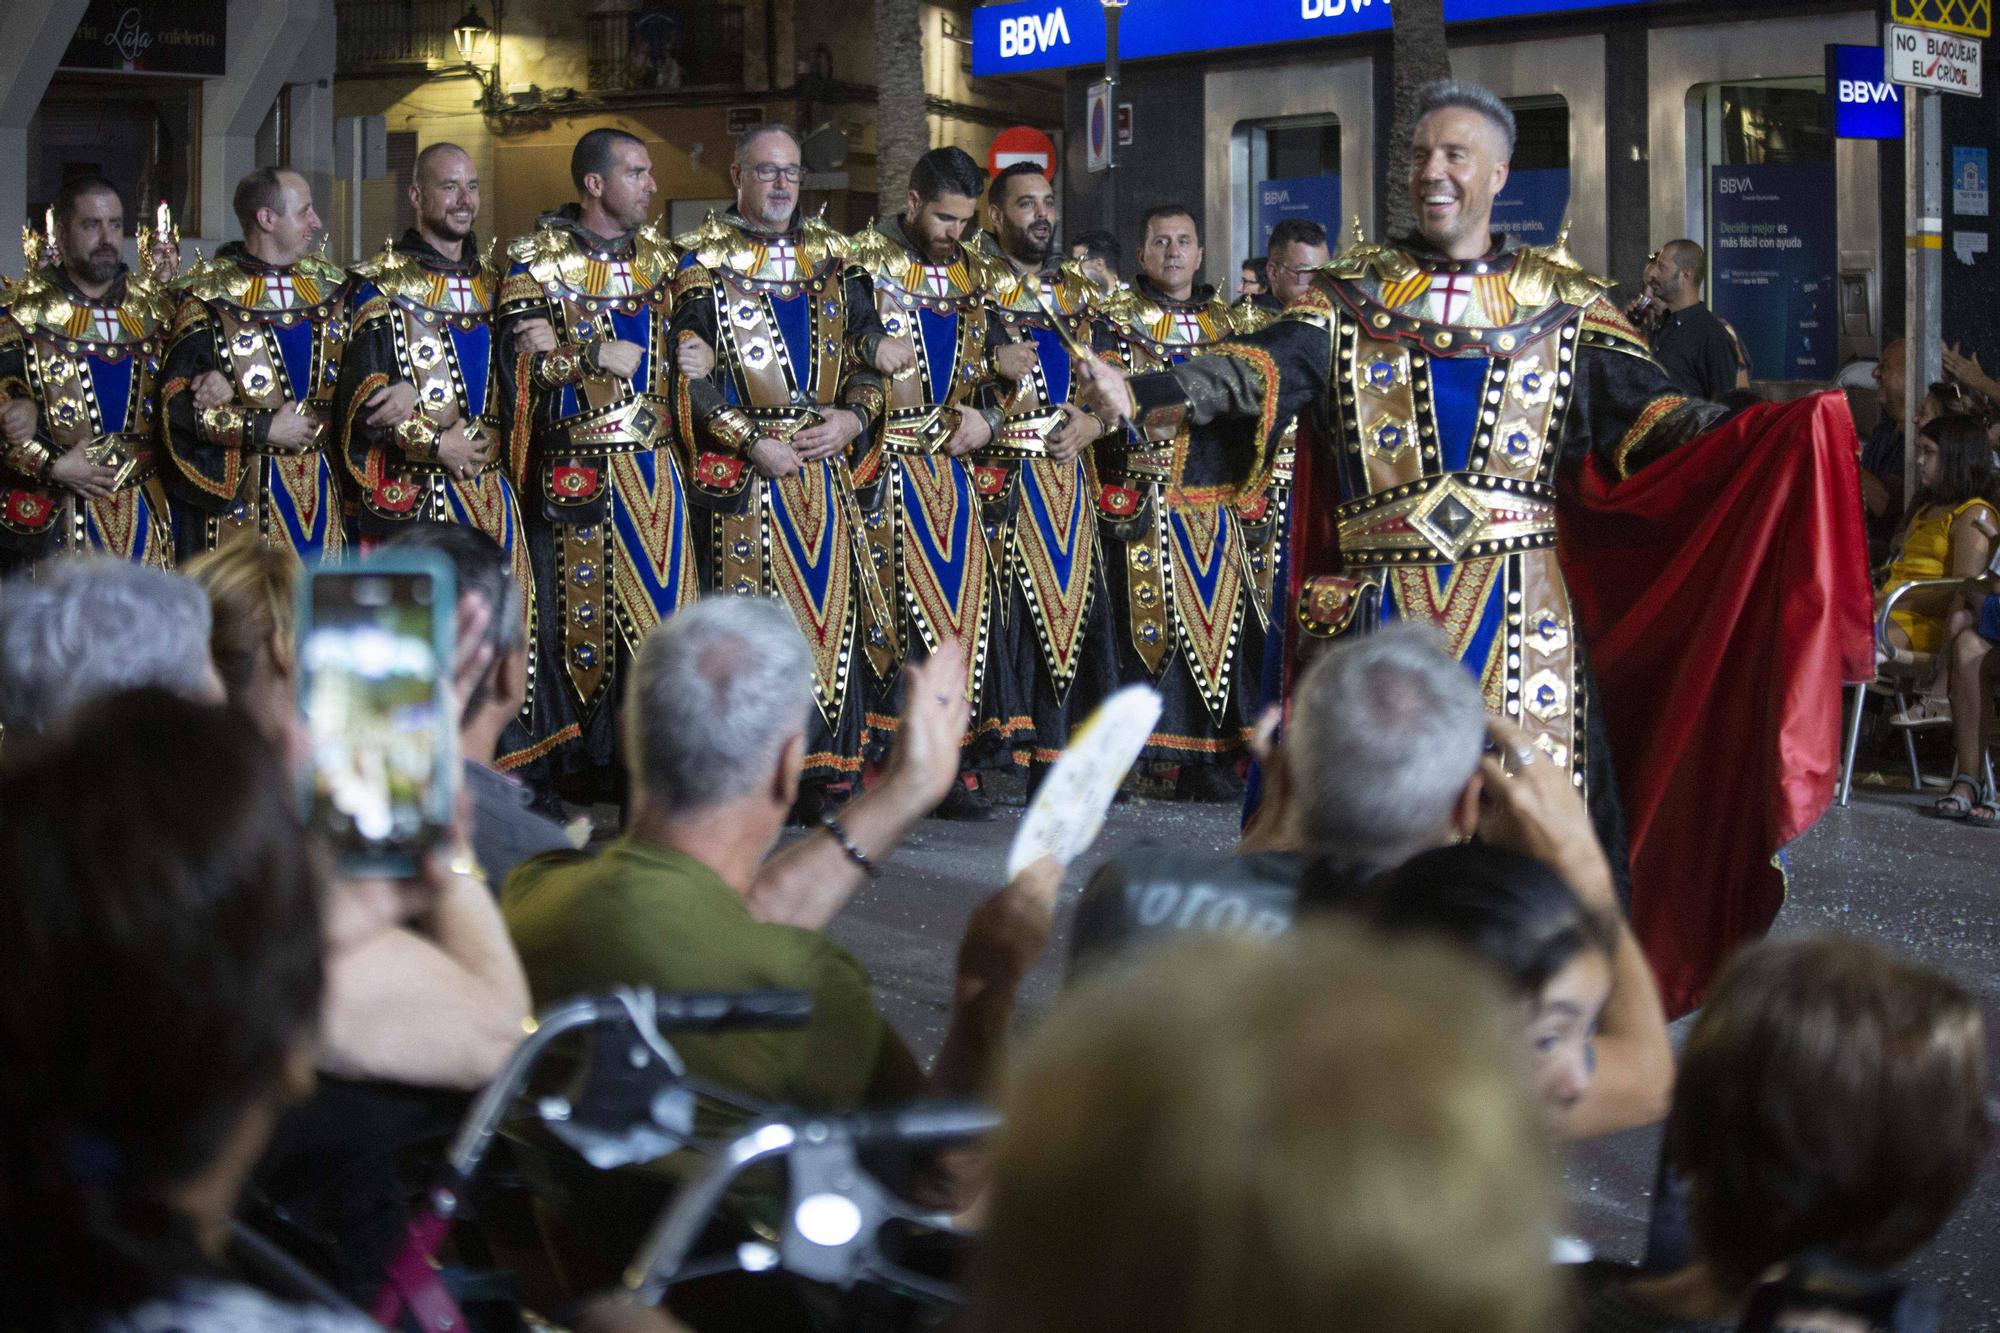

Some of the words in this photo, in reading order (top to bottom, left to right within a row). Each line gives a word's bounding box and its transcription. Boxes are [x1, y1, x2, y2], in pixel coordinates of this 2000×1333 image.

[1000, 7, 1070, 57] BBVA
[1896, 33, 1916, 52] NO
[1927, 39, 1977, 64] BLOQUEAR
[1913, 60, 1927, 78] EL
[1937, 64, 1967, 85] CRUCE
[1839, 79, 1898, 104] BBVA
[1720, 177, 1753, 193] BBVA
[1264, 190, 1290, 205] BBVA
[1720, 222, 1750, 234] Decidir
[1752, 222, 1776, 236] mejor
[1777, 224, 1788, 234] es
[1720, 236, 1738, 248] más
[1739, 236, 1758, 248] fácil
[1759, 238, 1775, 248] con
[1776, 236, 1802, 251] ayuda
